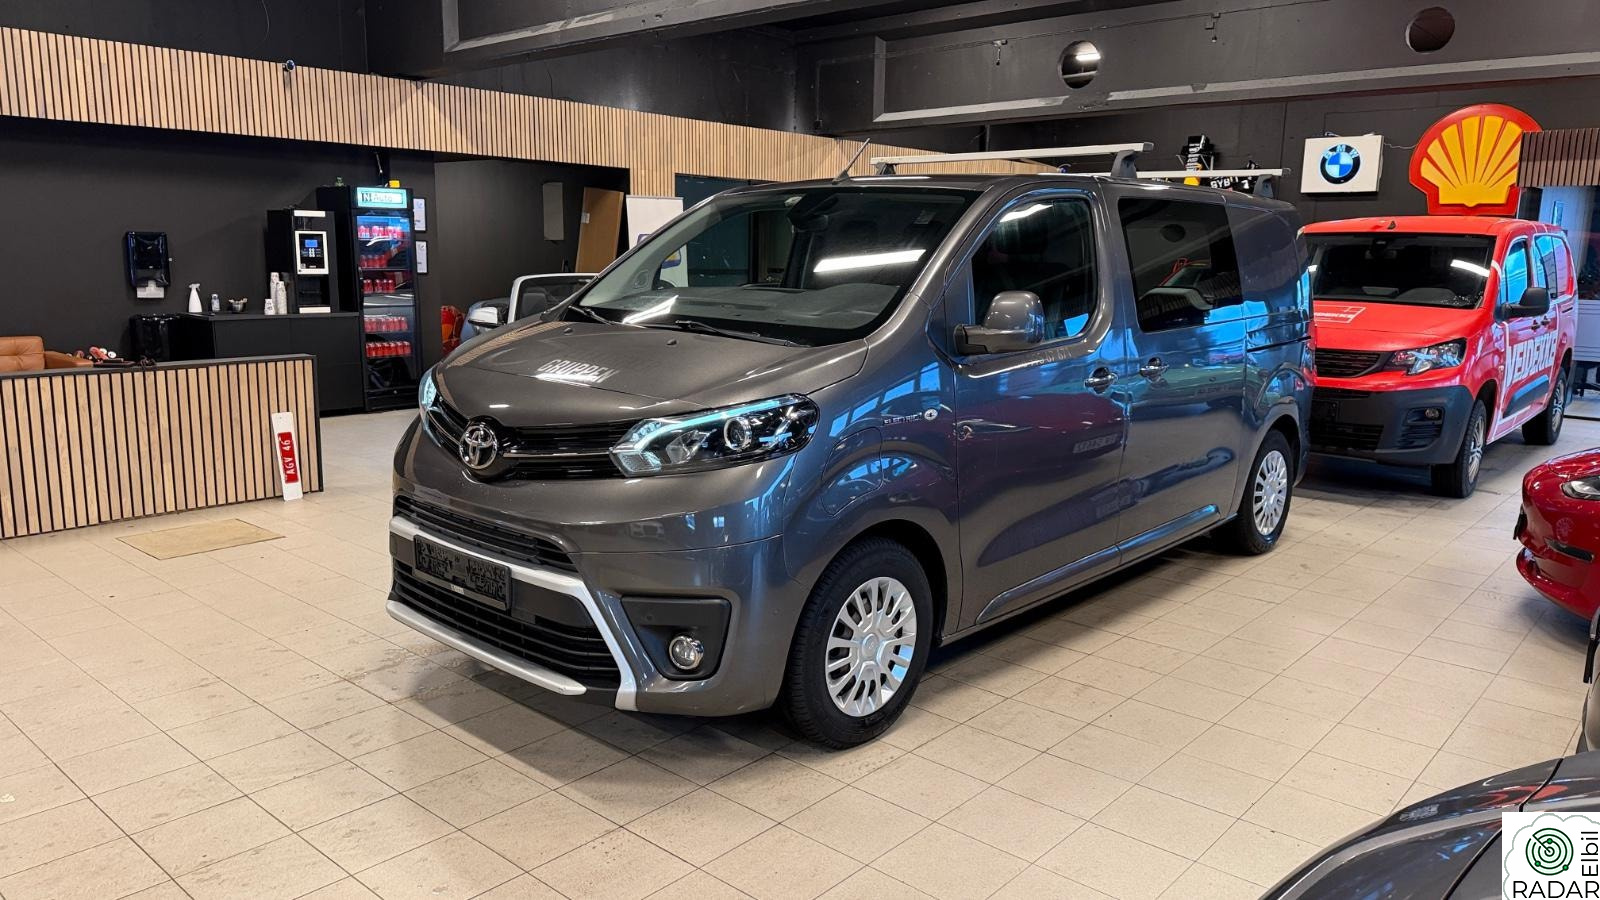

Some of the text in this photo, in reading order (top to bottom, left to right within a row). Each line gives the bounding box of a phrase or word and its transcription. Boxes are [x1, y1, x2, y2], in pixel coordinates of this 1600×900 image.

[1323, 144, 1359, 159] BMW
[537, 359, 621, 383] GRUPPEN
[1506, 331, 1557, 387] VEIDEKKE
[281, 440, 295, 474] AGV 46
